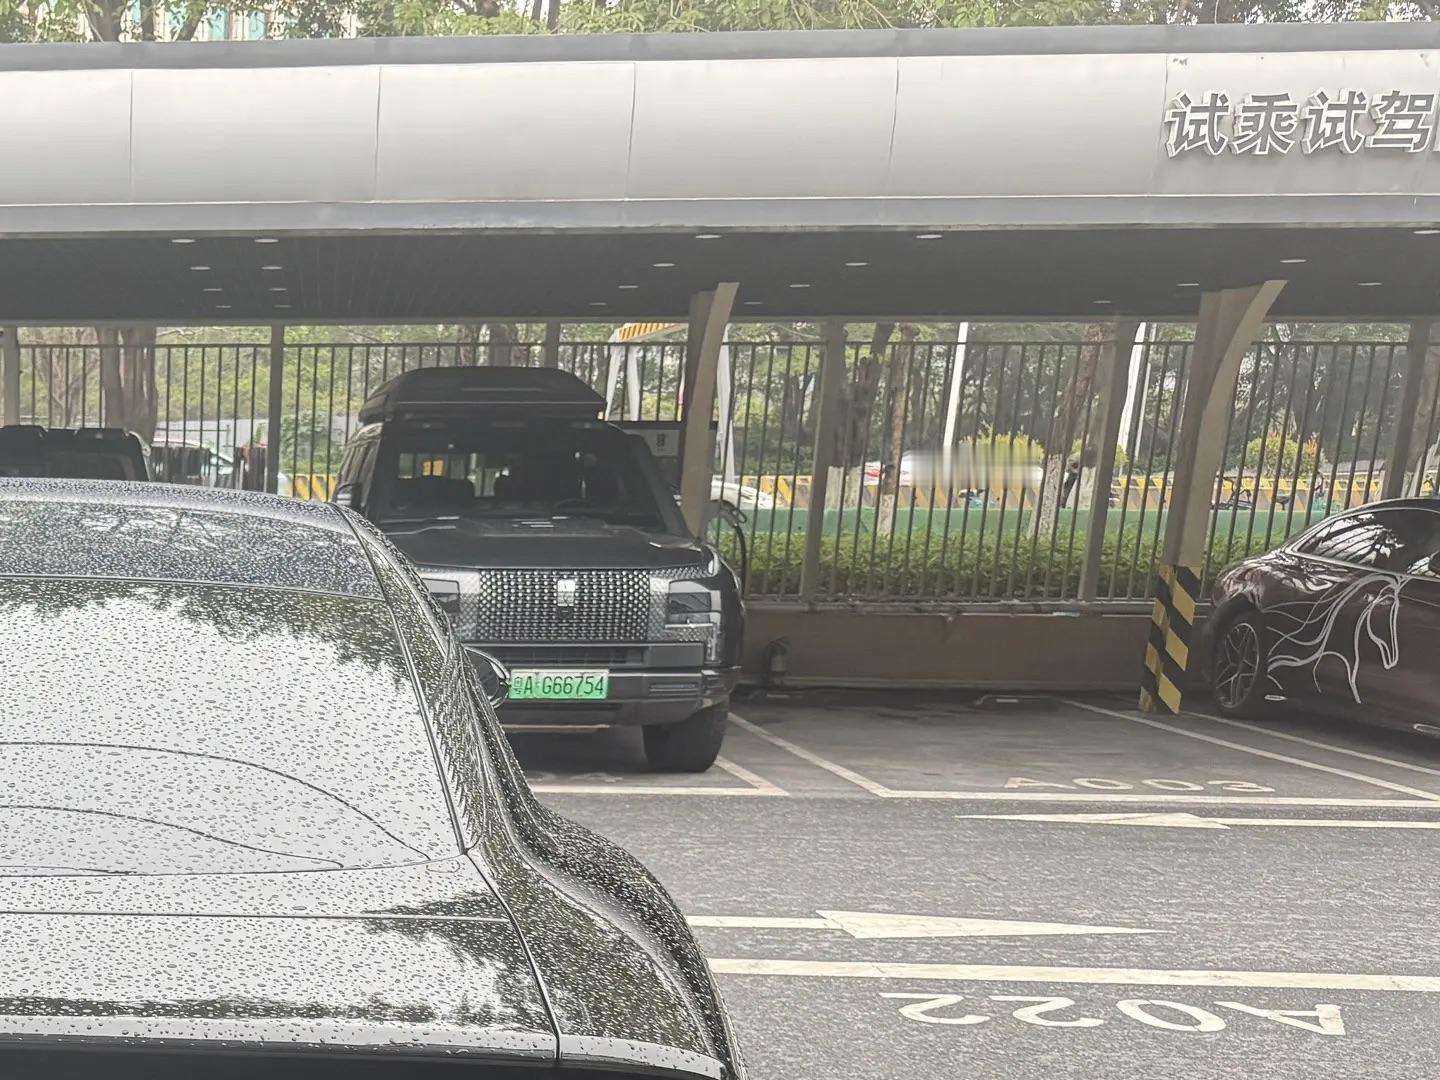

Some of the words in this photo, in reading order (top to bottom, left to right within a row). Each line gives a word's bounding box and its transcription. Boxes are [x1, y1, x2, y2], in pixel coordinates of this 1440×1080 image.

[1163, 88, 1435, 157] 试乘试驾
[1003, 777, 1276, 793] A003
[878, 993, 1347, 1036] A022
